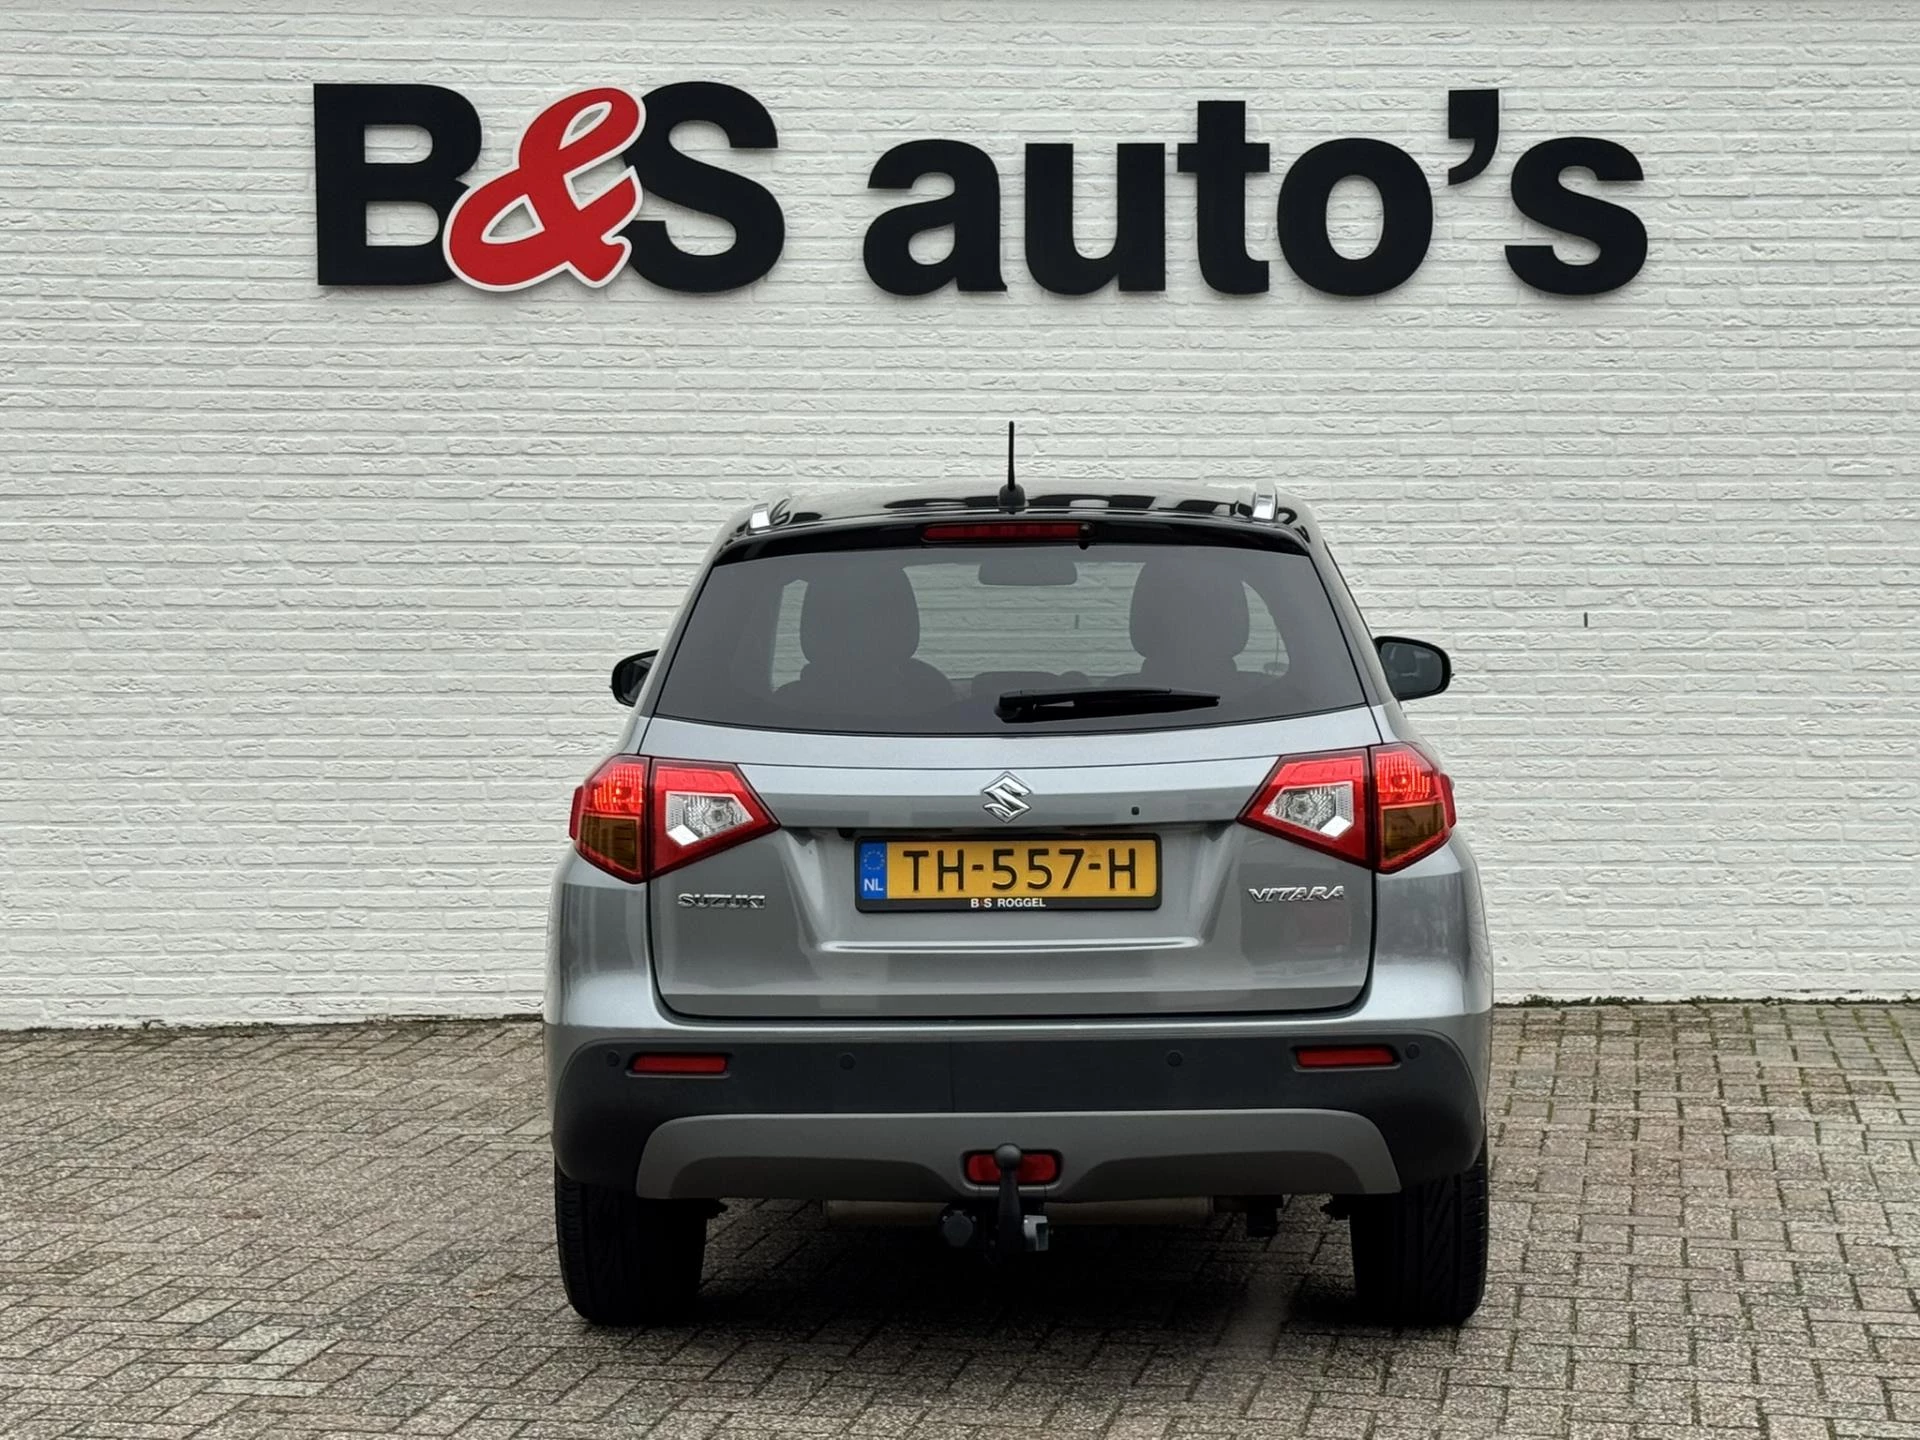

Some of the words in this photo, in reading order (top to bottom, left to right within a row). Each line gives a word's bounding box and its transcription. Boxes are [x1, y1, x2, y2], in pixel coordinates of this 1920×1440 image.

[314, 82, 785, 293] B&S
[863, 90, 1648, 297] auto's
[903, 848, 1137, 891] TH-557-H
[864, 878, 883, 891] NL
[677, 892, 765, 909] SUZUKI
[1248, 885, 1344, 902] VITARA
[997, 897, 1046, 908] ROGGEL
